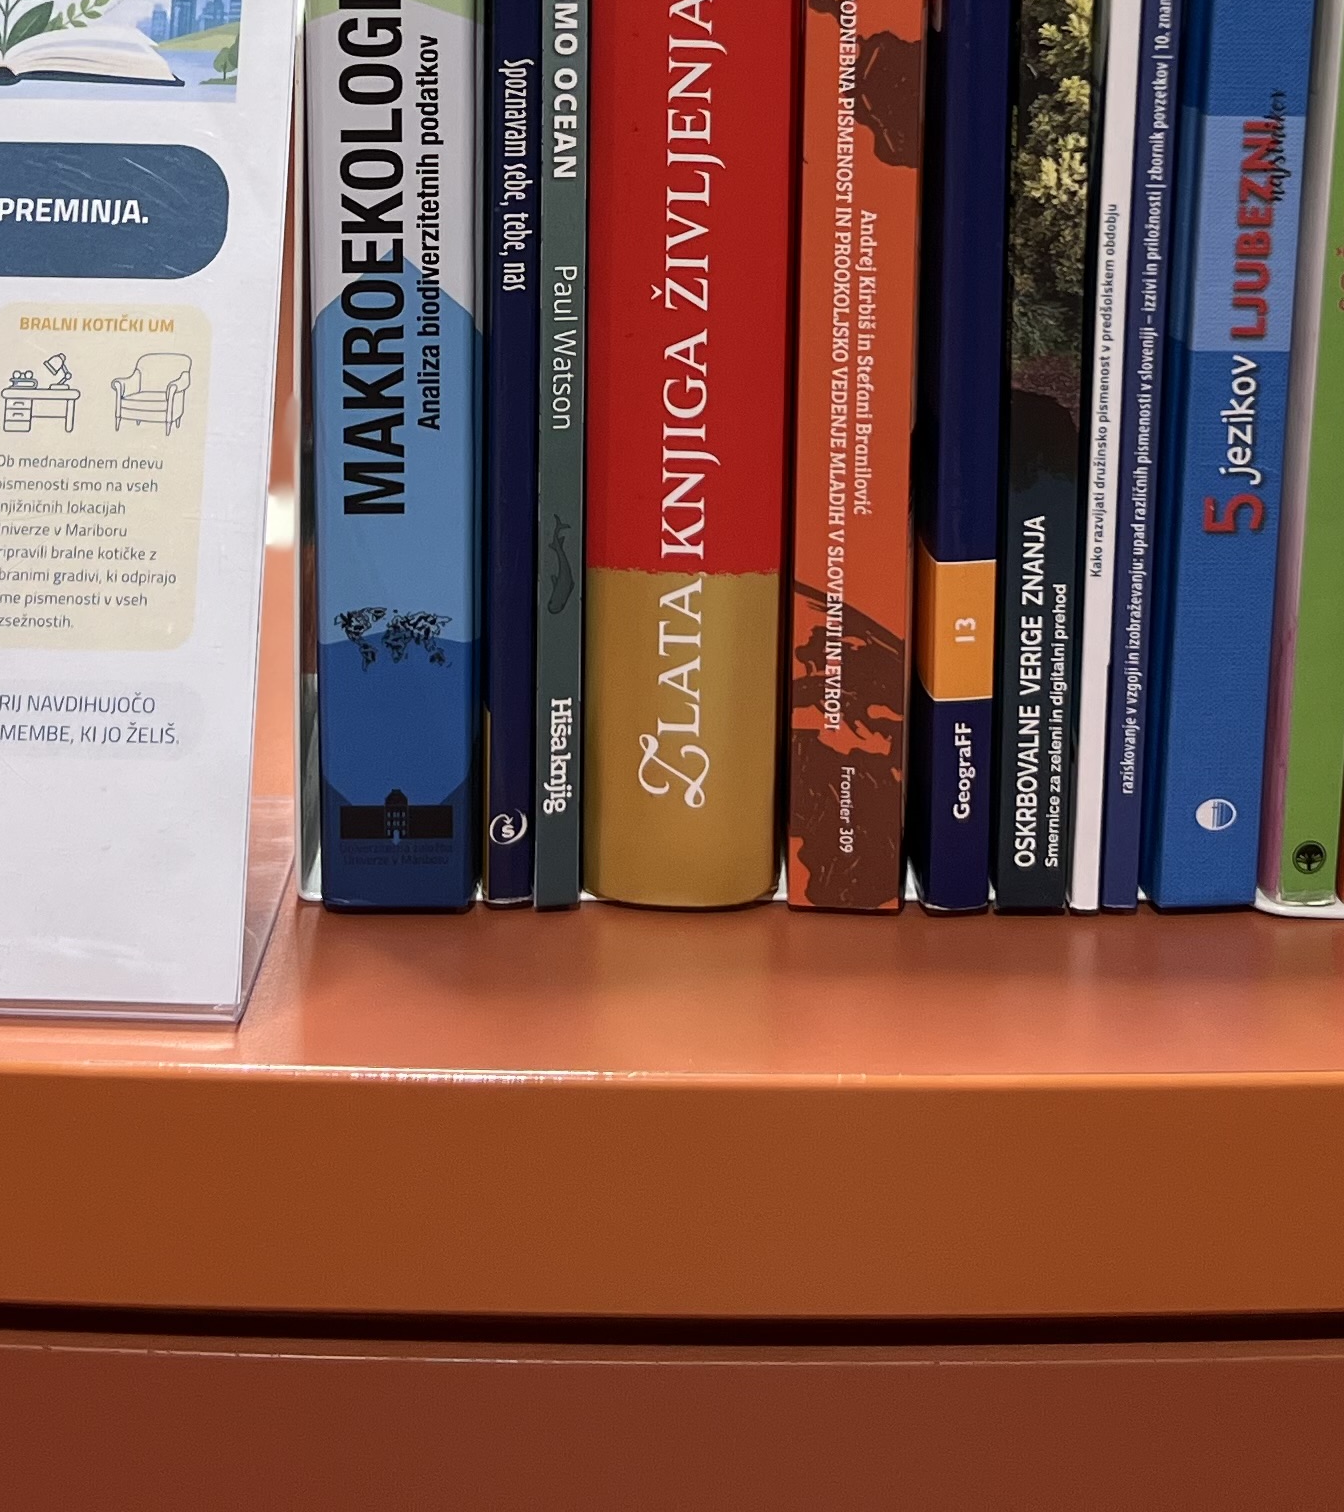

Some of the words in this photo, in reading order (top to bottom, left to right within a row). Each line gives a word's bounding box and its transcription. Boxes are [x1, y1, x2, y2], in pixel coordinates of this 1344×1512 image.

[415, 34, 444, 146] podatkov
[499, 58, 535, 157] Spoznavam
[553, 67, 578, 178] OCEAN
[498, 163, 533, 206] sebe,
[835, 97, 854, 203] PISMENOST
[415, 153, 440, 336] biodiverzitetnih
[498, 211, 533, 256] tebe,
[835, 206, 852, 227] IN
[1231, 120, 1279, 342] LJUBEZNI
[502, 262, 526, 291] nas
[553, 265, 578, 321] Paul
[831, 231, 851, 362] PROOKOLJSKO
[19, 317, 78, 331] BRALNI
[82, 314, 143, 332] KOTIČKI
[148, 319, 174, 332] UM
[416, 344, 440, 430] Analiza
[552, 329, 577, 429] Watson
[830, 365, 848, 448] VEDENJE
[1219, 354, 1262, 487] jezikov
[661, 328, 721, 559] KNJIGA
[828, 451, 846, 525] MLADIH
[1203, 492, 1267, 535] 5
[828, 528, 845, 543] V
[1021, 515, 1046, 605] ZNANJA
[825, 545, 844, 637] SLOVENIJI
[638, 572, 709, 808] ZLATA
[825, 641, 842, 661] IN
[1019, 615, 1043, 696] VERIGE
[823, 664, 841, 730] EVROPI
[839, 766, 855, 824] Frontier
[952, 722, 976, 819] GeograFF
[1013, 704, 1041, 867] OSKRBOVALNE
[839, 827, 854, 853] 309
